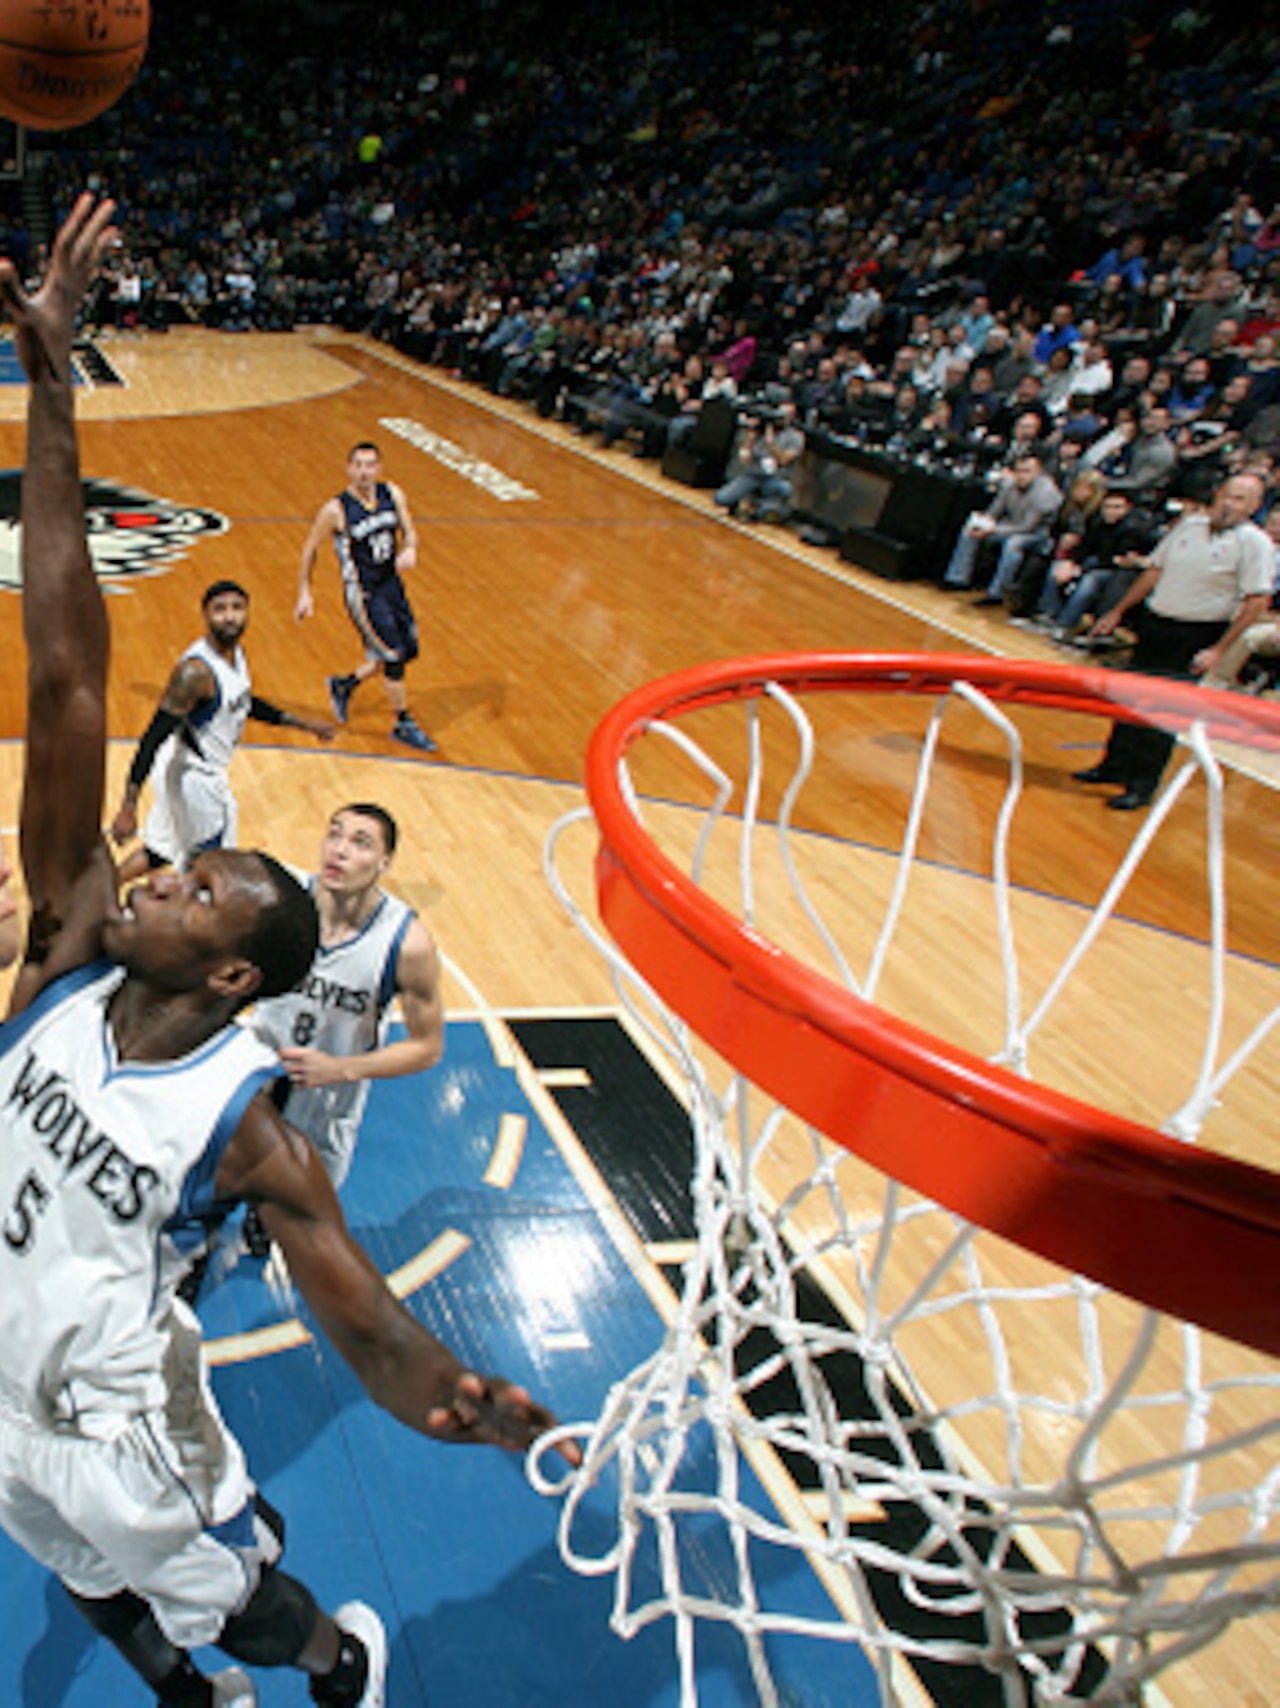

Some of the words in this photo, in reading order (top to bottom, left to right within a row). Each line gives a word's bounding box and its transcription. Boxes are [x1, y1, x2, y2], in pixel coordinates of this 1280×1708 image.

[293, 1013, 315, 1046] 8
[0, 1048, 160, 1224] WOLVES
[3, 1169, 52, 1255] 5
